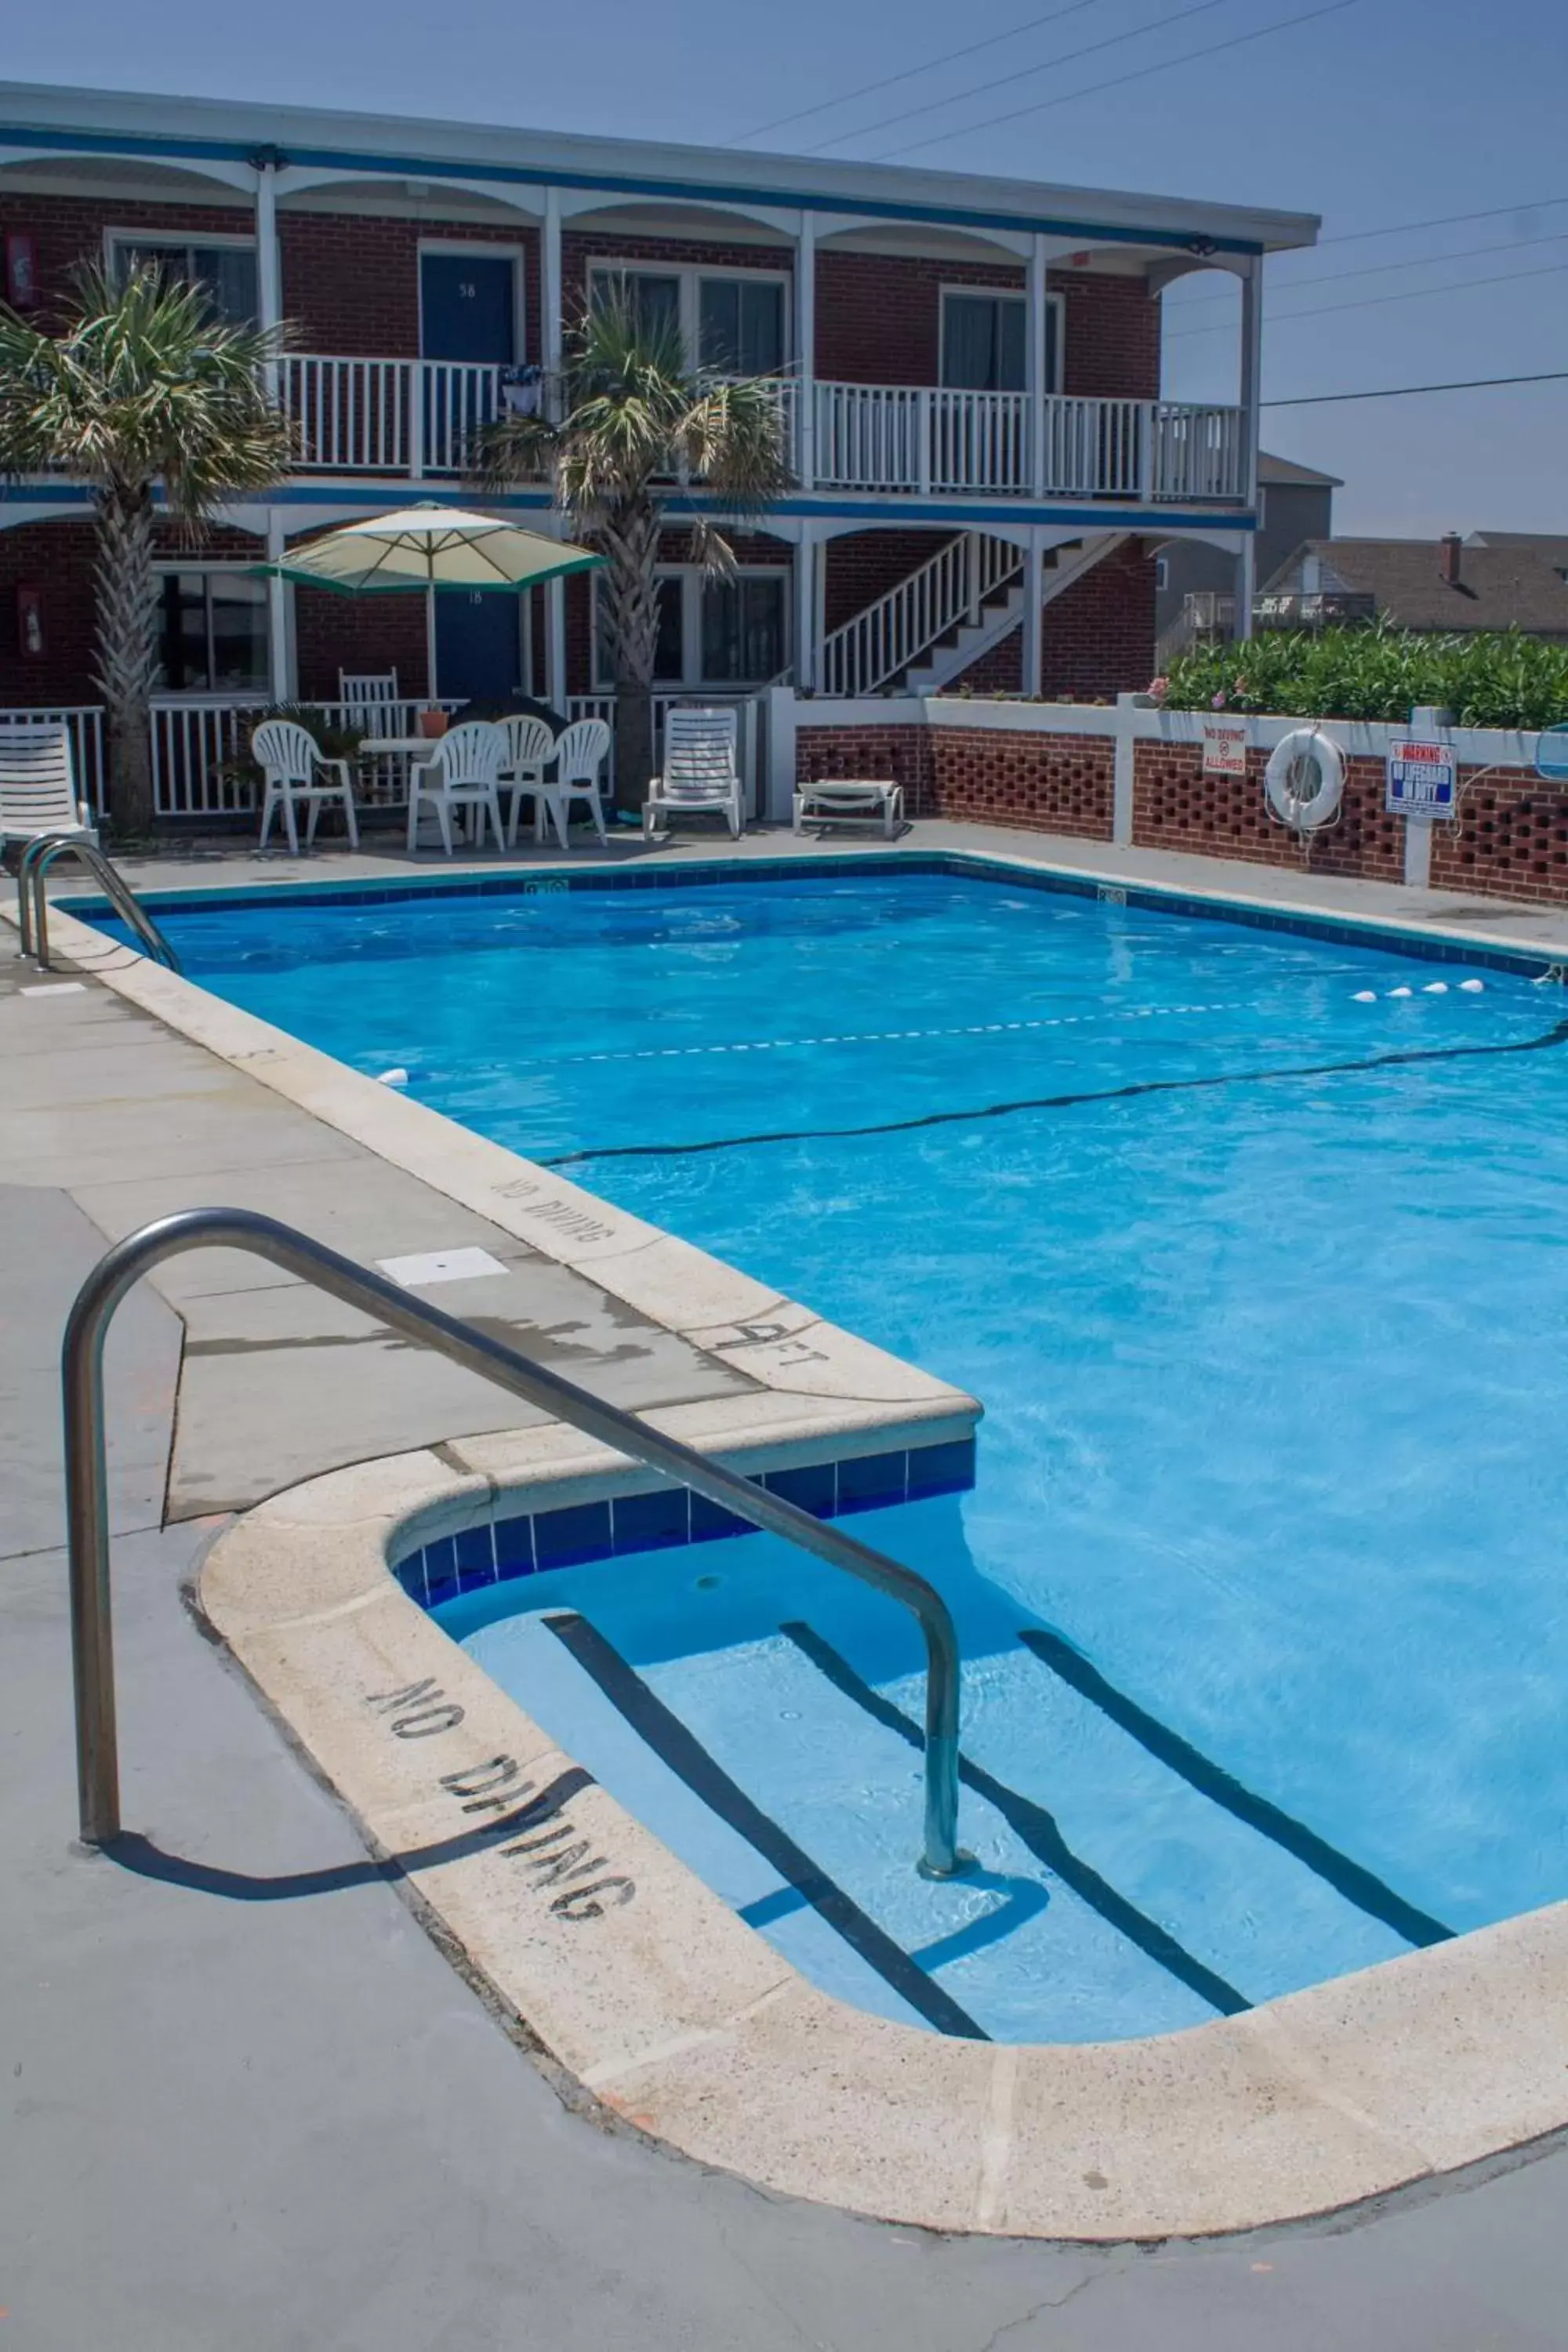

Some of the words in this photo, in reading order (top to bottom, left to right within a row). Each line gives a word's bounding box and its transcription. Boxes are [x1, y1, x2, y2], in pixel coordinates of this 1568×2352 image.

[1204, 724, 1215, 739] NO
[1218, 728, 1244, 742] DIVING
[1206, 757, 1243, 771] ALLOWED
[1403, 744, 1440, 764] WARNING
[490, 1178, 539, 1198] NO
[521, 1200, 615, 1243] DIVING
[365, 1676, 466, 1739] NO
[439, 1753, 636, 1921] DIVING
